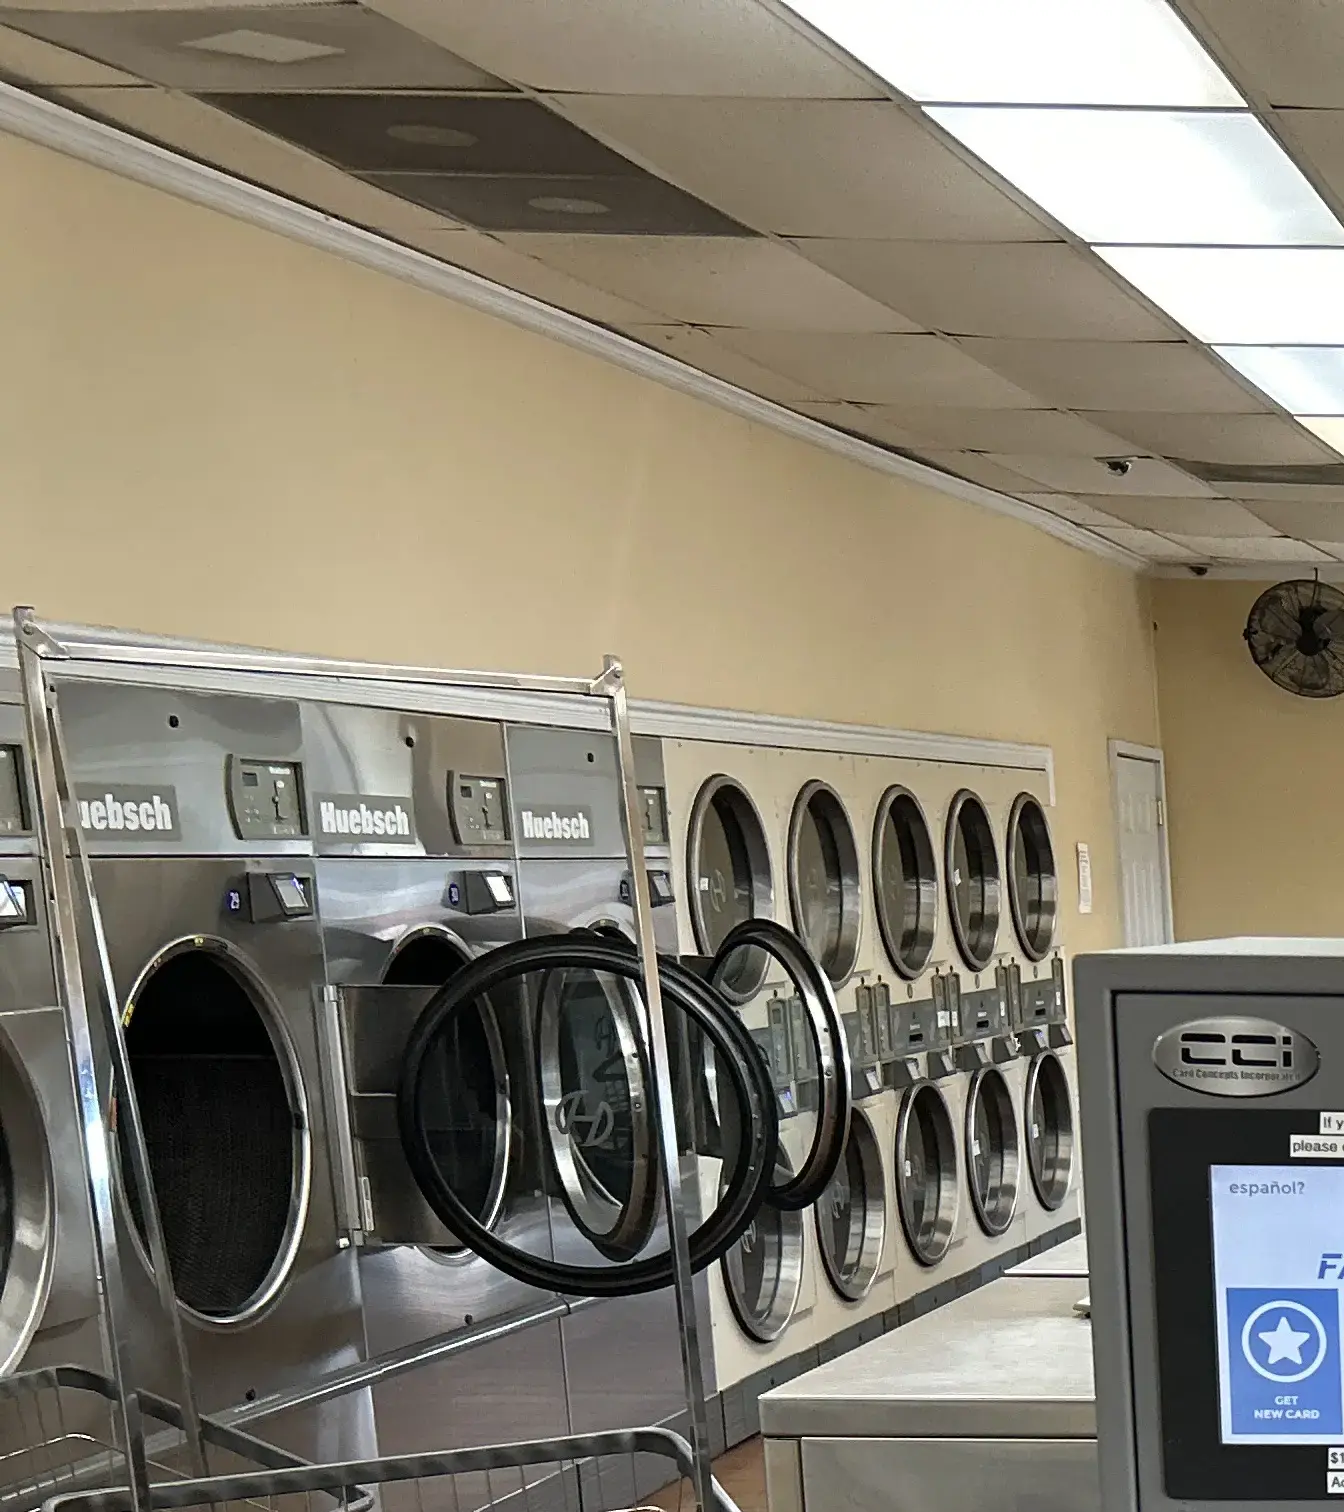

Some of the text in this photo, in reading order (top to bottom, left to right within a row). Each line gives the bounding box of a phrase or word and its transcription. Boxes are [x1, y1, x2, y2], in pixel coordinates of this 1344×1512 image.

[78, 793, 173, 831] uebsch
[320, 800, 410, 836] Huebsch
[522, 810, 589, 840] Huebsch
[1323, 1117, 1331, 1128] If
[1293, 1140, 1337, 1153] please
[1229, 1181, 1305, 1197] español?
[1275, 1396, 1298, 1406] GET
[1254, 1409, 1320, 1419] NEW CARD
